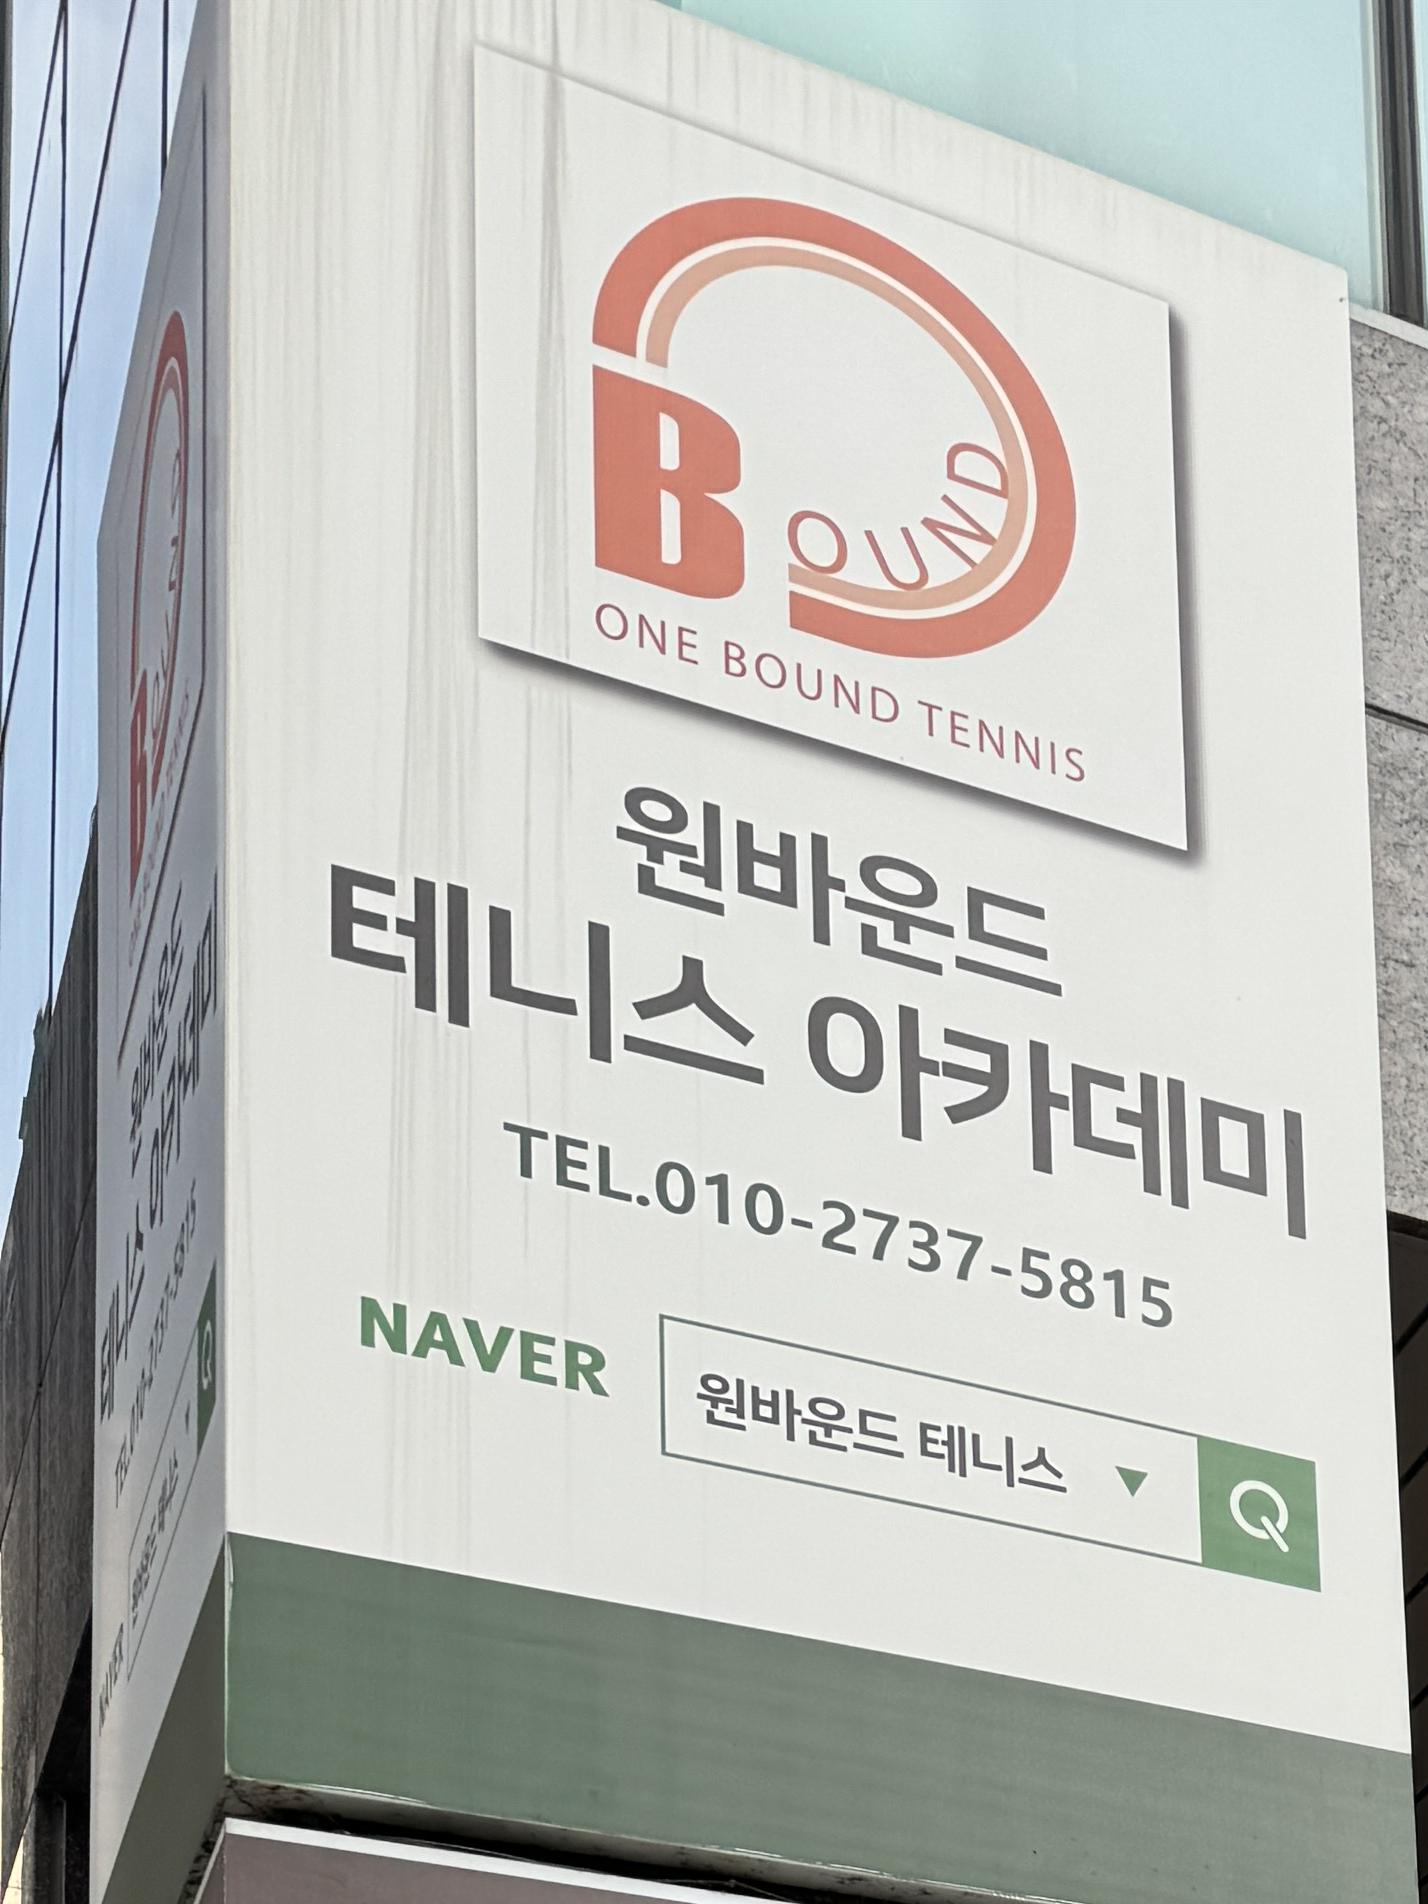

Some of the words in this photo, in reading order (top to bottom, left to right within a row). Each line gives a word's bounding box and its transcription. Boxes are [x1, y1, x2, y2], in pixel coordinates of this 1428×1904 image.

[594, 602, 699, 667] ONE
[722, 640, 901, 725] BOUND
[918, 699, 1087, 784] TENNIS
[616, 786, 1062, 997] 원바운드
[129, 880, 183, 1180] 원바운드
[330, 864, 764, 1085] 테니스
[806, 996, 1307, 1240] 아카데미
[100, 1200, 145, 1424] 테니스
[149, 868, 217, 1229] 아카데미
[503, 1121, 1174, 1328] TEL.010-2737-5815
[359, 1295, 610, 1397] NAVER
[696, 1371, 904, 1458] 원바운드
[917, 1421, 1067, 1493] 테니스
